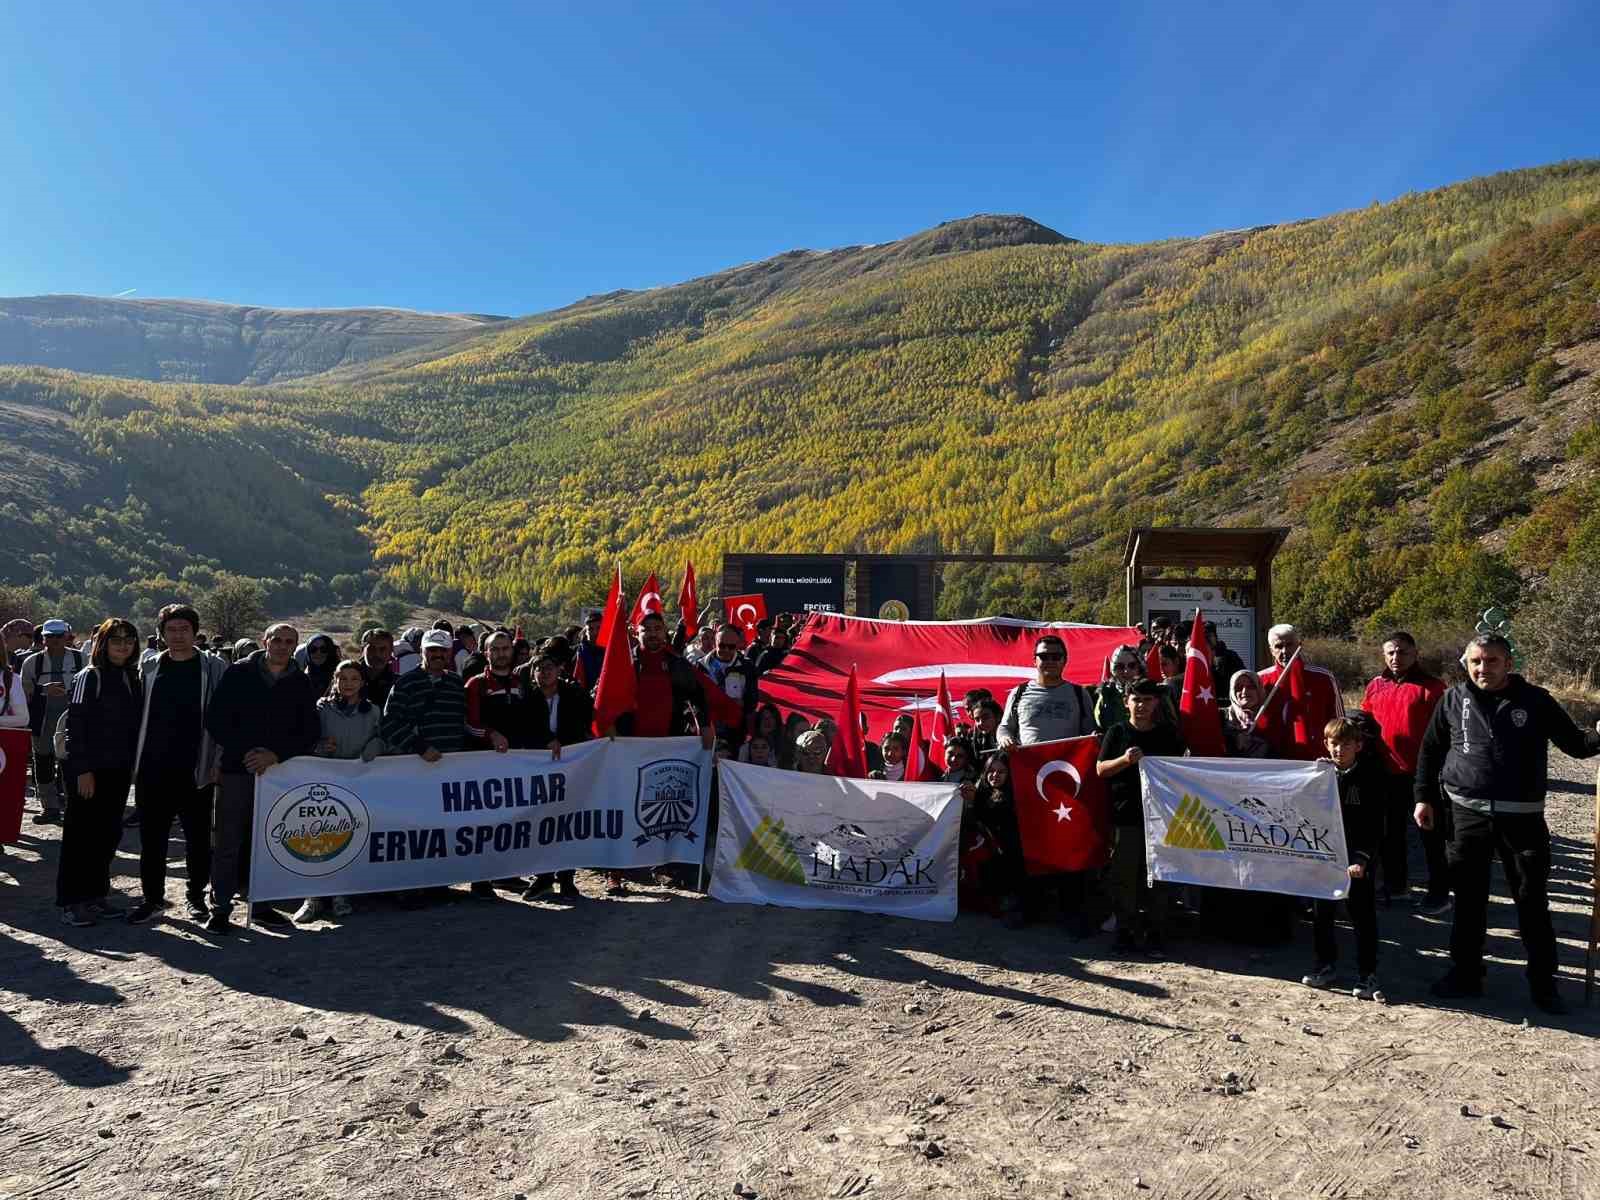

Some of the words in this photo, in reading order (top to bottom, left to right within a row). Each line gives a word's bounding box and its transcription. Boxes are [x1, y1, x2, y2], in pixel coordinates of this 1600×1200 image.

[441, 773, 566, 813] HACILAR
[298, 806, 338, 818] ERVA
[270, 822, 306, 845] Spor
[368, 828, 448, 863] ERVA
[455, 821, 532, 857] SPOR
[538, 809, 624, 846] OKULU
